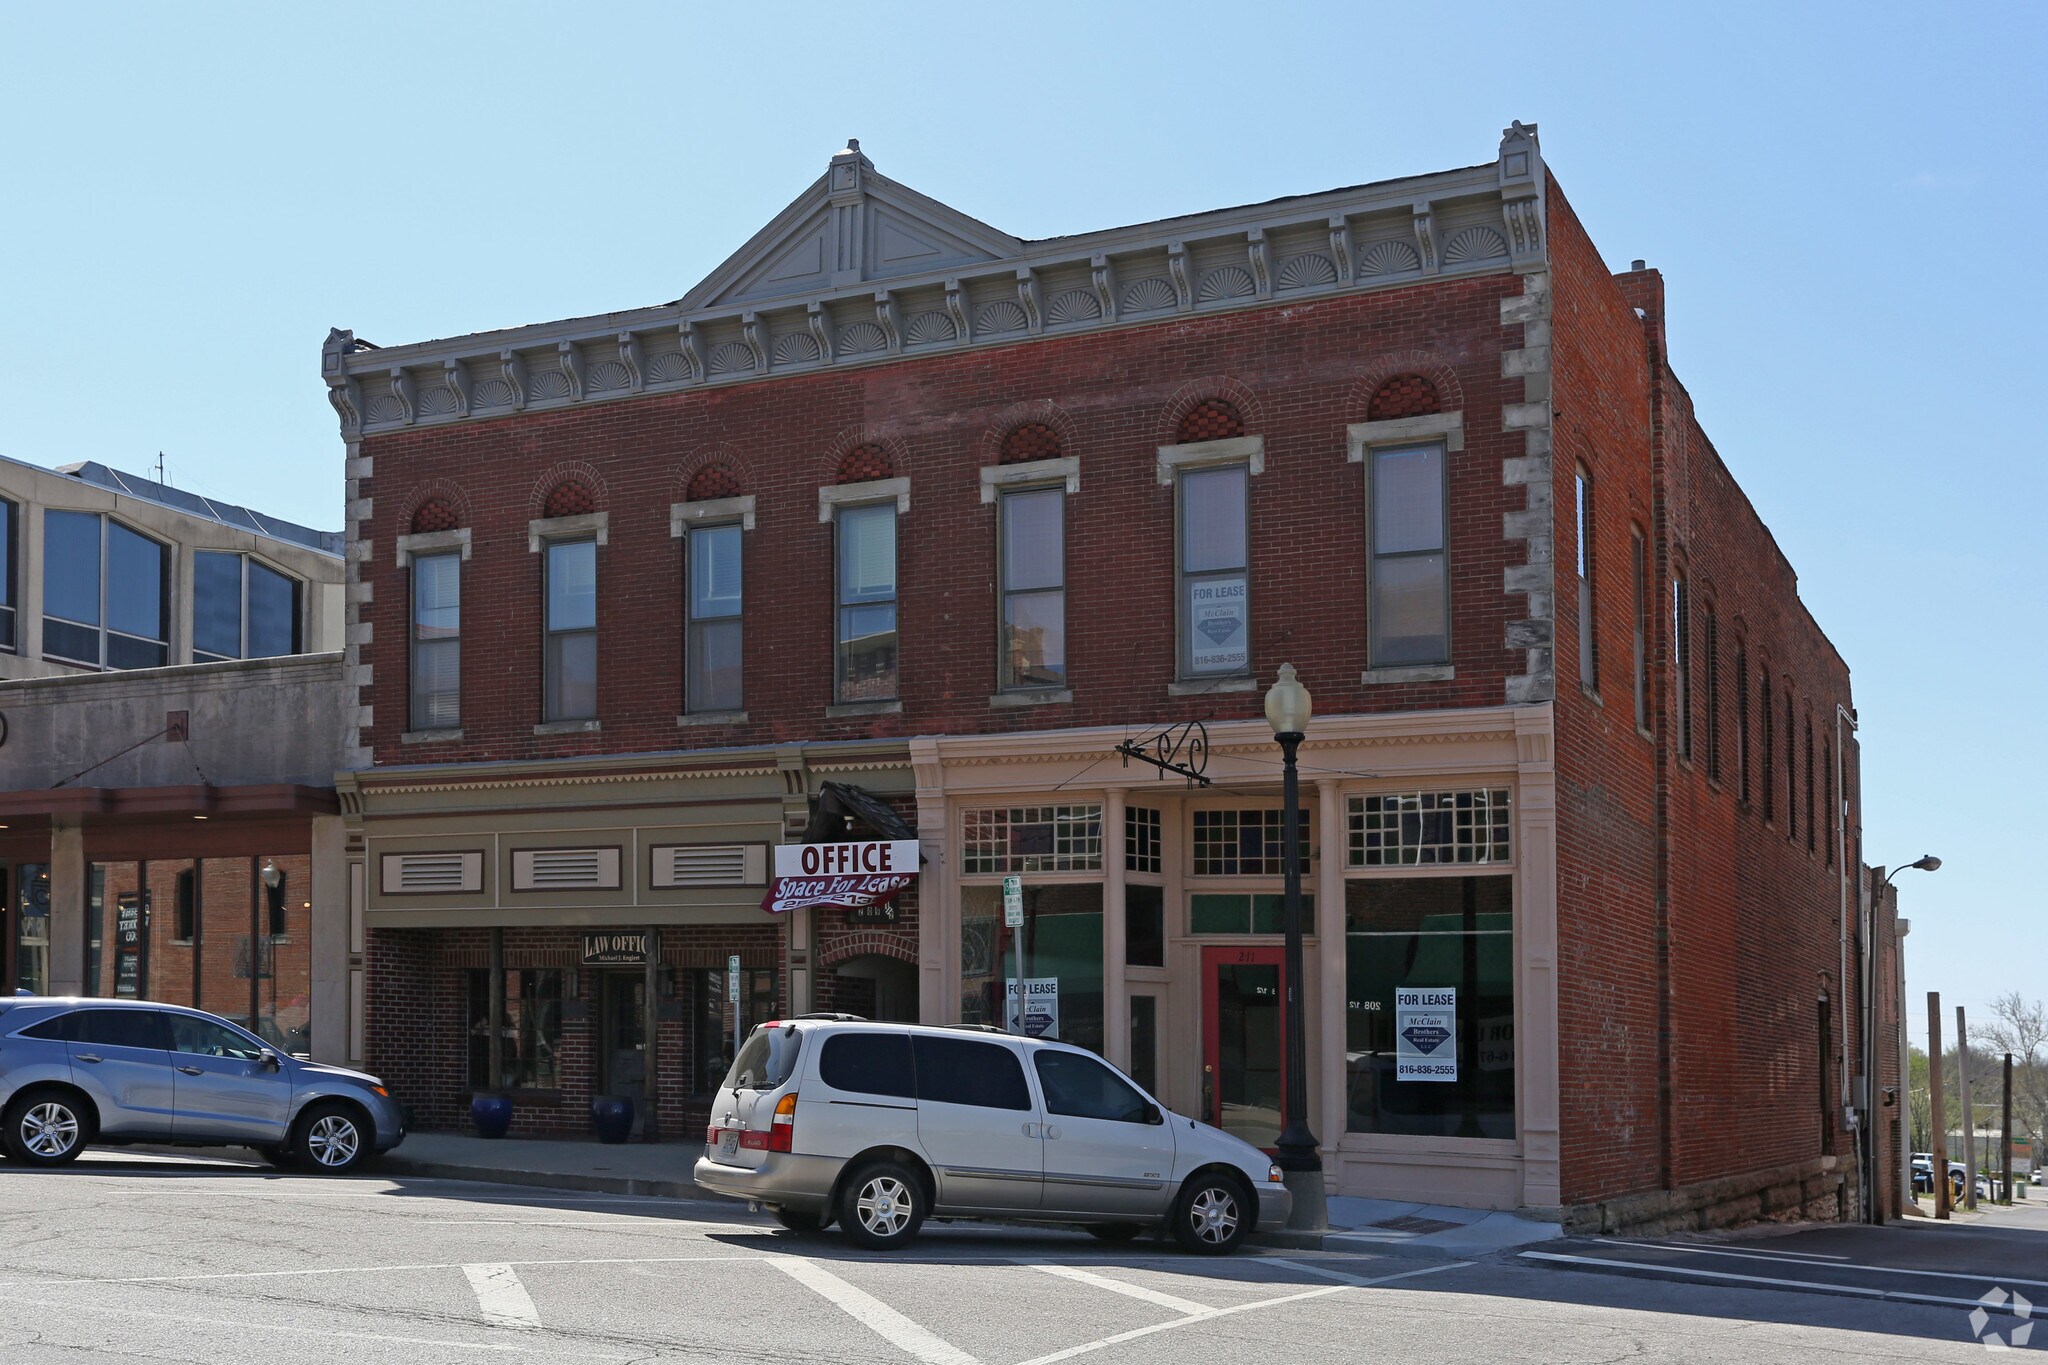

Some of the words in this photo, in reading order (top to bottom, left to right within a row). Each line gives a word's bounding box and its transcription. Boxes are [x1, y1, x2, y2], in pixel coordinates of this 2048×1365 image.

[1193, 588, 1213, 600] FOR
[1215, 585, 1245, 598] LEASE
[1204, 609, 1234, 617] McClain
[1194, 653, 1246, 665] 816-836-2555
[801, 843, 892, 875] OFFICE
[775, 877, 826, 900] Space
[827, 876, 857, 894] For
[857, 875, 911, 893] Lease
[584, 936, 610, 958] LAW
[612, 935, 647, 954] OFFIC
[1239, 952, 1255, 961] 211
[1029, 983, 1056, 994] LEASE
[1398, 994, 1419, 1006] FOR
[1422, 994, 1454, 1006] LEASE
[1409, 1018, 1442, 1026] McClain
[1399, 1064, 1455, 1075] 816-836-2555
